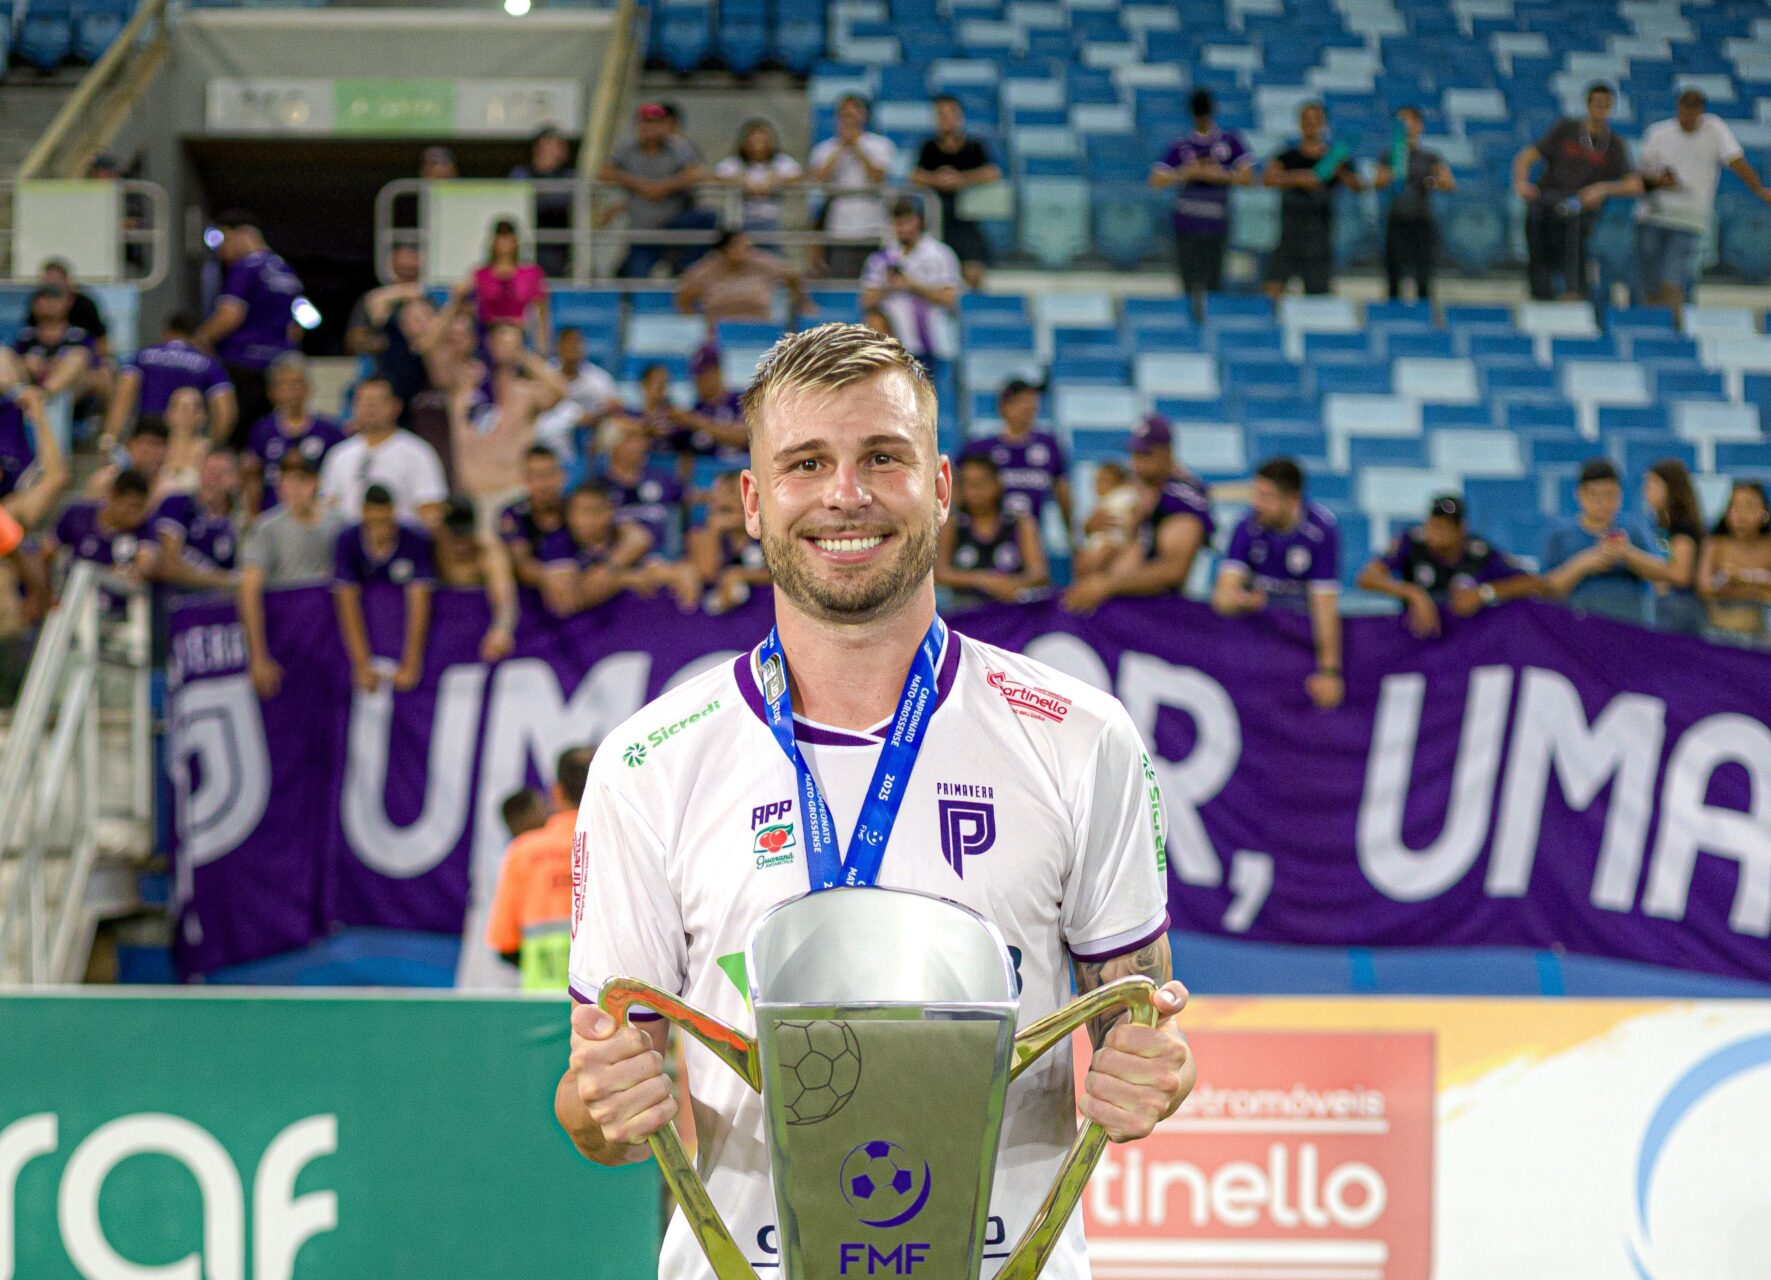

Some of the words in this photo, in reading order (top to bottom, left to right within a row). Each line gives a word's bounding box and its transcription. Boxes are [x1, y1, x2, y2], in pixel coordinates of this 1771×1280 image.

[647, 700, 720, 748] Sicredi
[905, 687, 930, 743] CAMPEONATO
[340, 650, 750, 890] UM
[1356, 664, 1771, 938] UMA
[879, 773, 896, 801] 2025
[936, 782, 994, 799] PRIMAVERA
[815, 782, 831, 844] AMPEONATO
[840, 1243, 931, 1275] FMF
